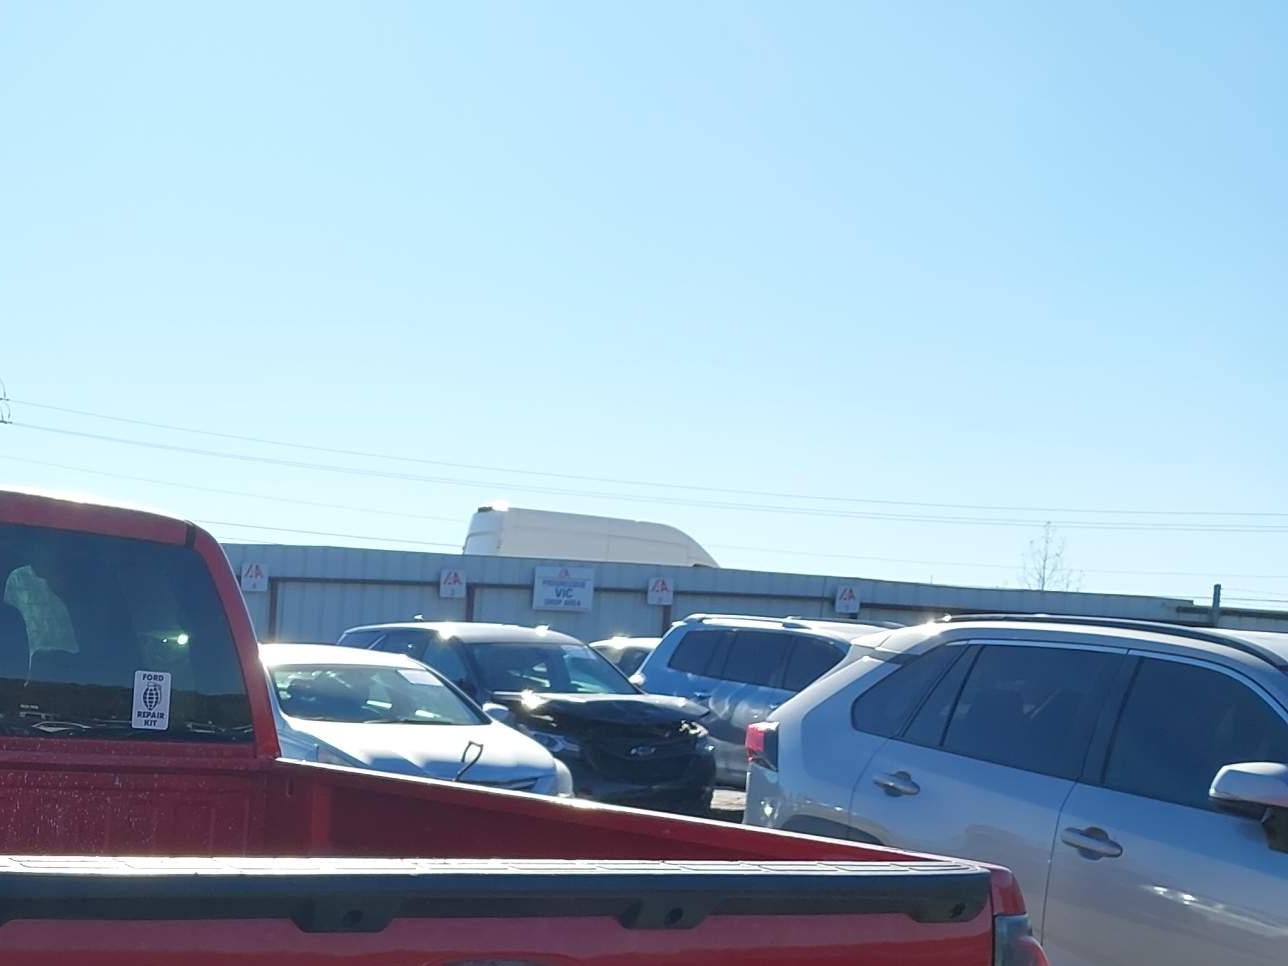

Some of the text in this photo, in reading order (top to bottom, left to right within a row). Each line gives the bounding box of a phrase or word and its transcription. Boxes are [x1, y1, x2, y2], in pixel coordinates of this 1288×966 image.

[554, 587, 574, 598] VIC
[142, 673, 164, 681] FORD
[137, 711, 165, 719] REPAIR
